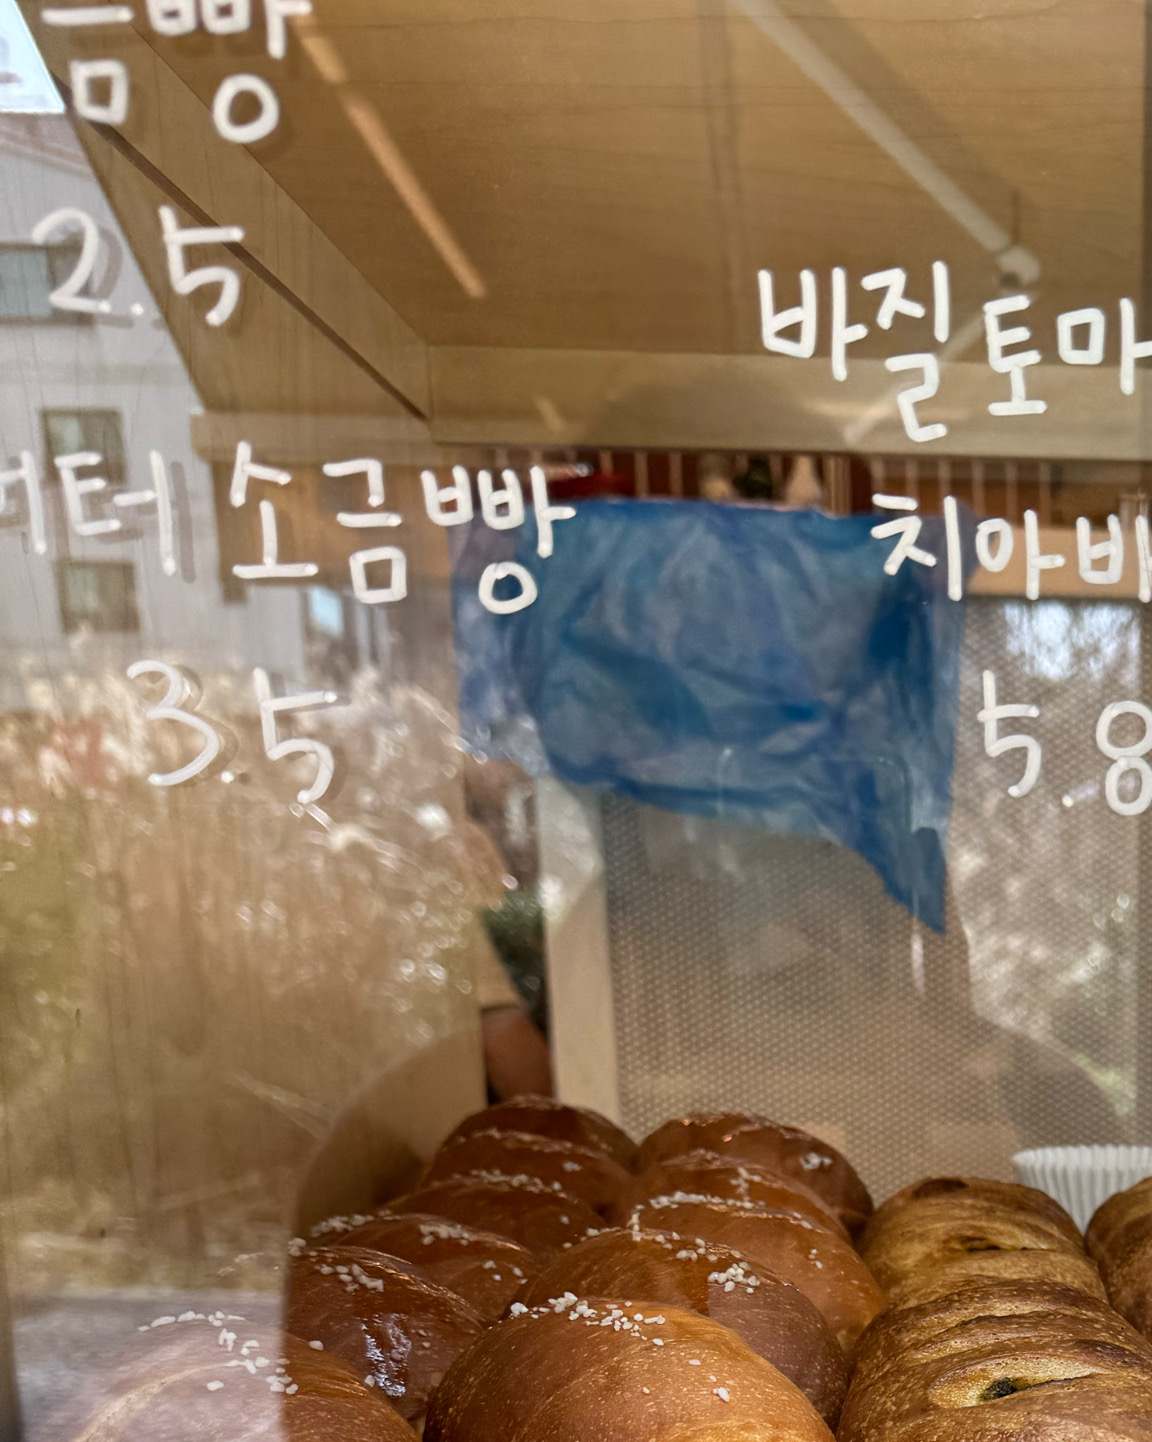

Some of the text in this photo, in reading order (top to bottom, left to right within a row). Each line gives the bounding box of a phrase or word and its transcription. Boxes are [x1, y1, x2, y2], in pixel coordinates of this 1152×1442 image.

[32, 207, 244, 327] 2.5
[230, 441, 576, 614] 소금빵
[126, 660, 340, 805] 3.5
